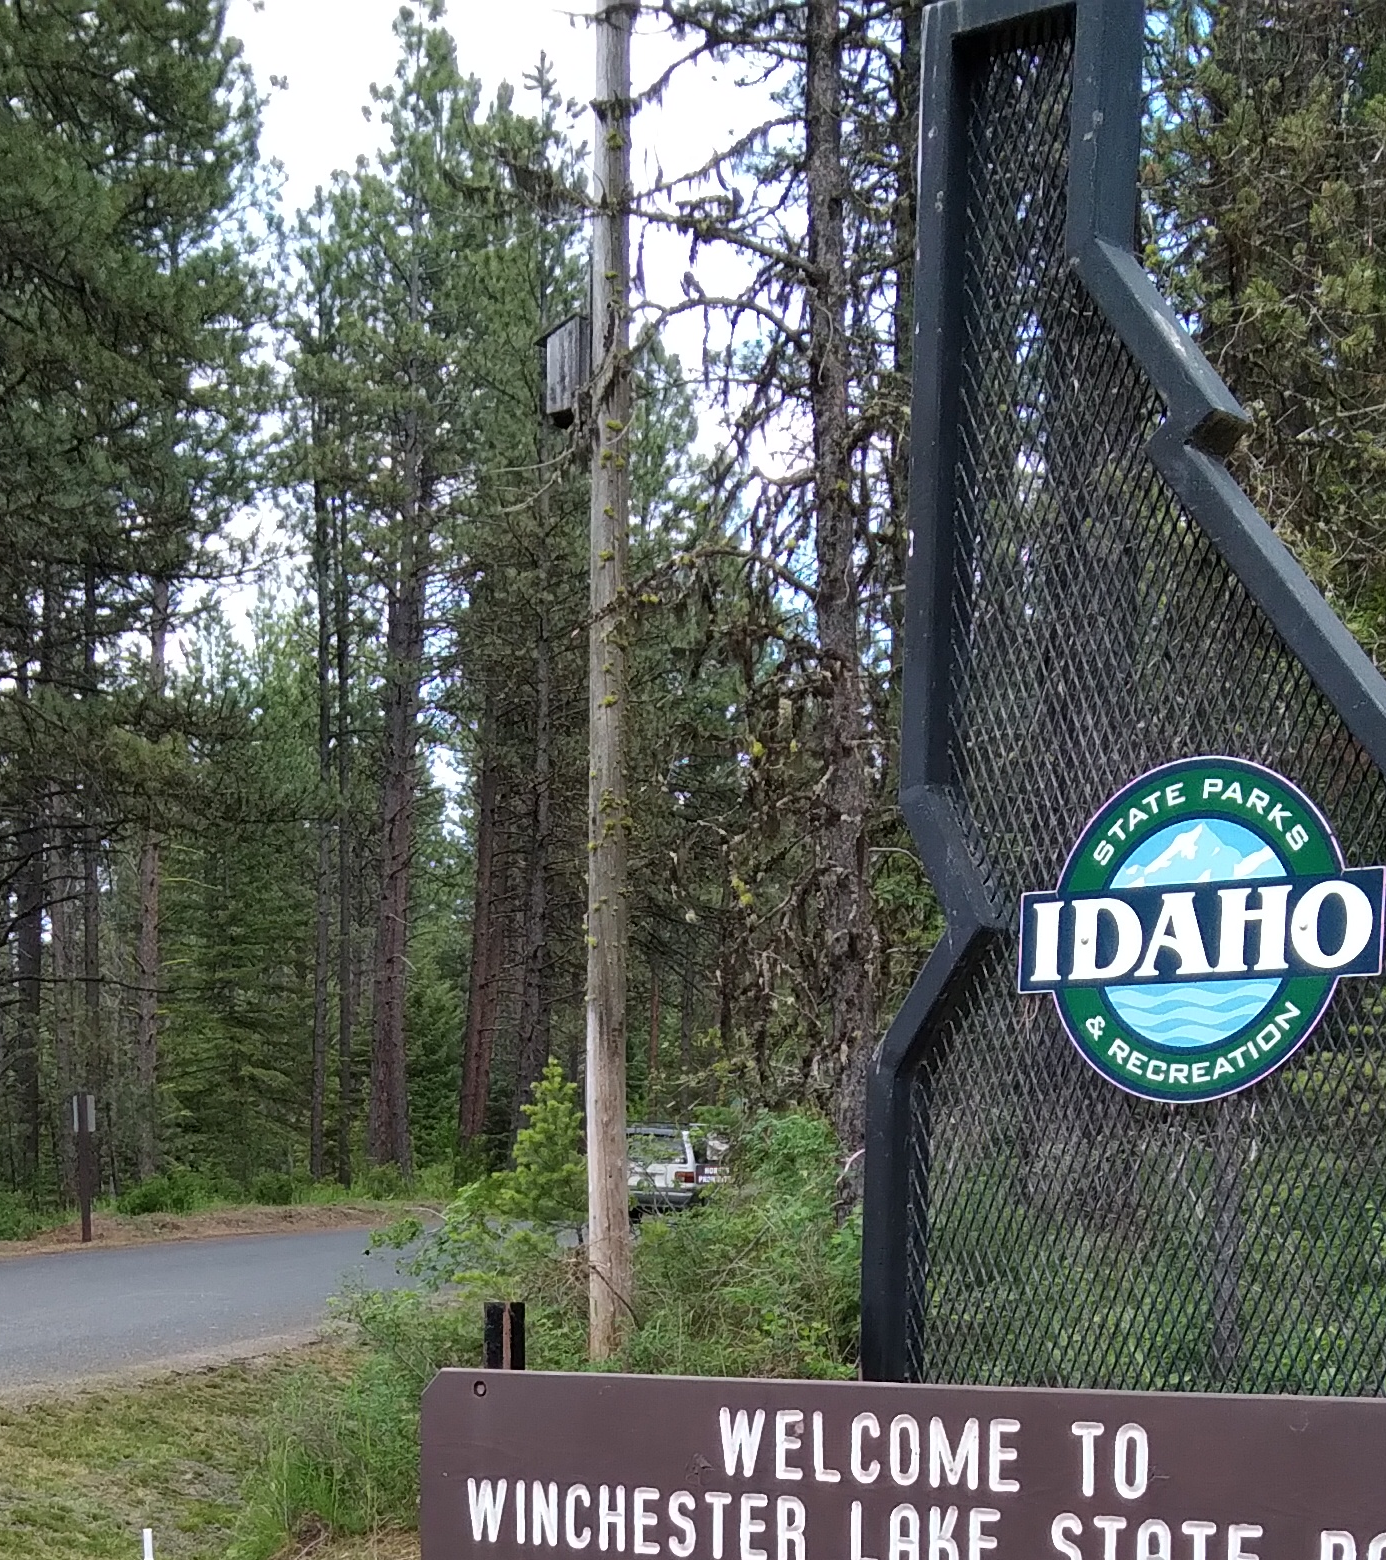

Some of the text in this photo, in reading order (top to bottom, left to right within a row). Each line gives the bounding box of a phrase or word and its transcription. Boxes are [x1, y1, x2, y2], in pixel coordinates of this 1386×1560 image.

[1093, 778, 1310, 866] STATE PARKS
[1029, 880, 1374, 982] IDAHO
[1085, 1001, 1302, 1085] & RECREATION
[718, 1406, 1149, 1500] WELCOME TO
